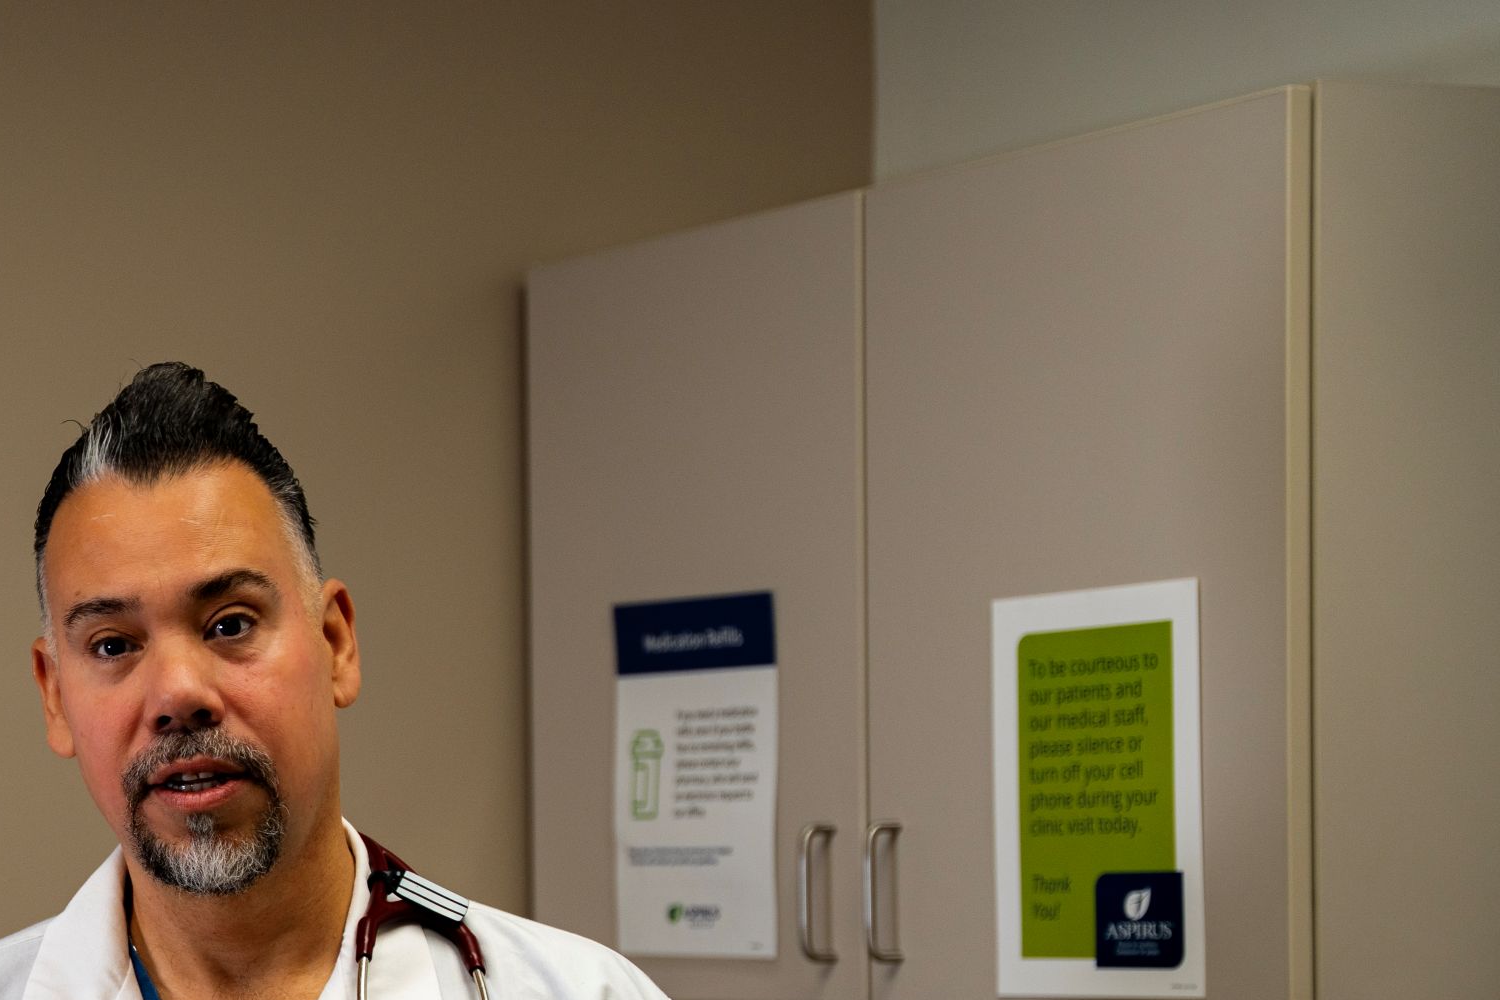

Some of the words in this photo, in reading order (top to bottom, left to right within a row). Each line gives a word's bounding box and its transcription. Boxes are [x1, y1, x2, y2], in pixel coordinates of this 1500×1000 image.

[642, 629, 705, 653] Medication
[707, 625, 743, 649] Refills
[1028, 659, 1045, 679] To
[1049, 659, 1066, 679] be
[1070, 655, 1140, 676] courteous
[1142, 653, 1159, 671] to
[1029, 688, 1052, 706] our
[1056, 682, 1112, 706] patients
[1115, 679, 1143, 699] and
[1029, 714, 1052, 732] our
[1056, 708, 1110, 730] medical
[1113, 703, 1148, 727] staff,
[1029, 739, 1073, 760] please
[1077, 737, 1125, 756] silence
[1128, 736, 1143, 753] or
[1029, 766, 1059, 785] turn
[1062, 761, 1081, 783] off
[1084, 764, 1116, 787] your
[1119, 760, 1143, 780] cell
[1029, 792, 1073, 812] phone
[1077, 790, 1123, 813] during
[1125, 788, 1159, 811] your
[1029, 818, 1063, 837] clinic
[1066, 816, 1094, 836] visit
[1097, 815, 1142, 839] today.
[1032, 873, 1072, 895] Thank
[1104, 920, 1173, 941] ASPIRUS
